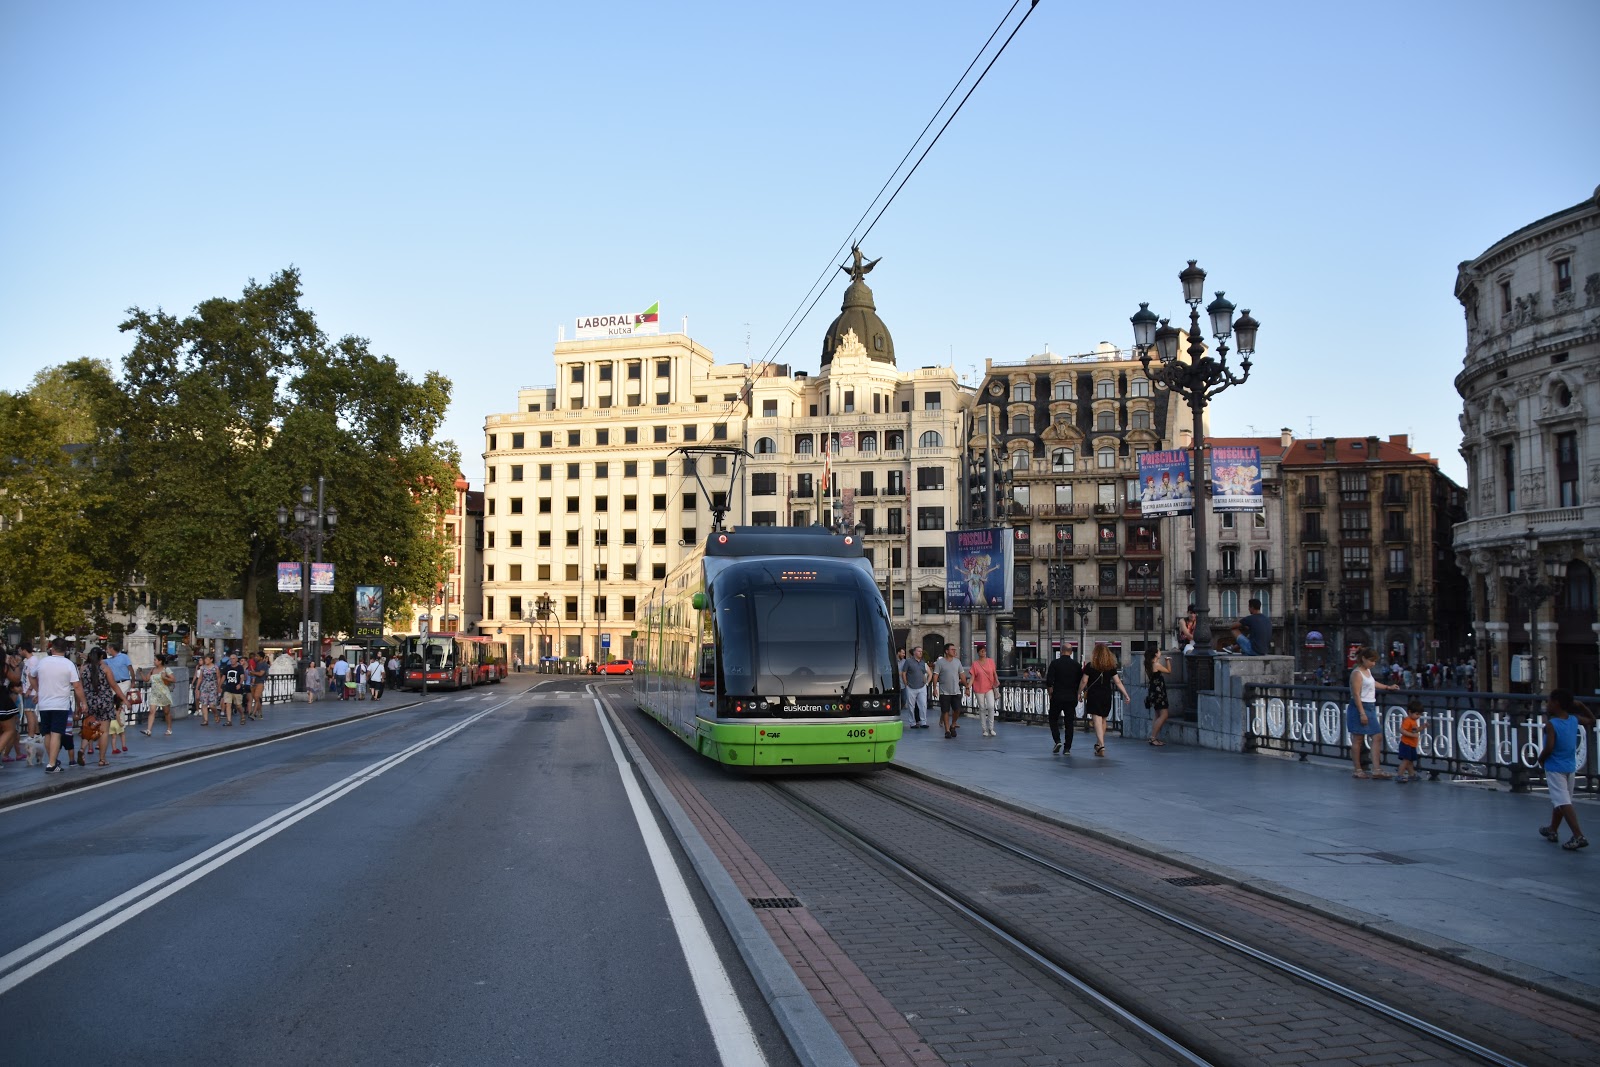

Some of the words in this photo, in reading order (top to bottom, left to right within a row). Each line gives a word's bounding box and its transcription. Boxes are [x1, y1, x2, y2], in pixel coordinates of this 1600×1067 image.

[577, 315, 631, 328] LABORAL
[608, 327, 631, 335] kutxa
[1141, 450, 1185, 464] PRISCILLA
[1212, 447, 1256, 459] PRISCILLA
[959, 531, 992, 545] PRISCILLA
[357, 627, 380, 635] 20:46
[847, 729, 866, 738] 406
